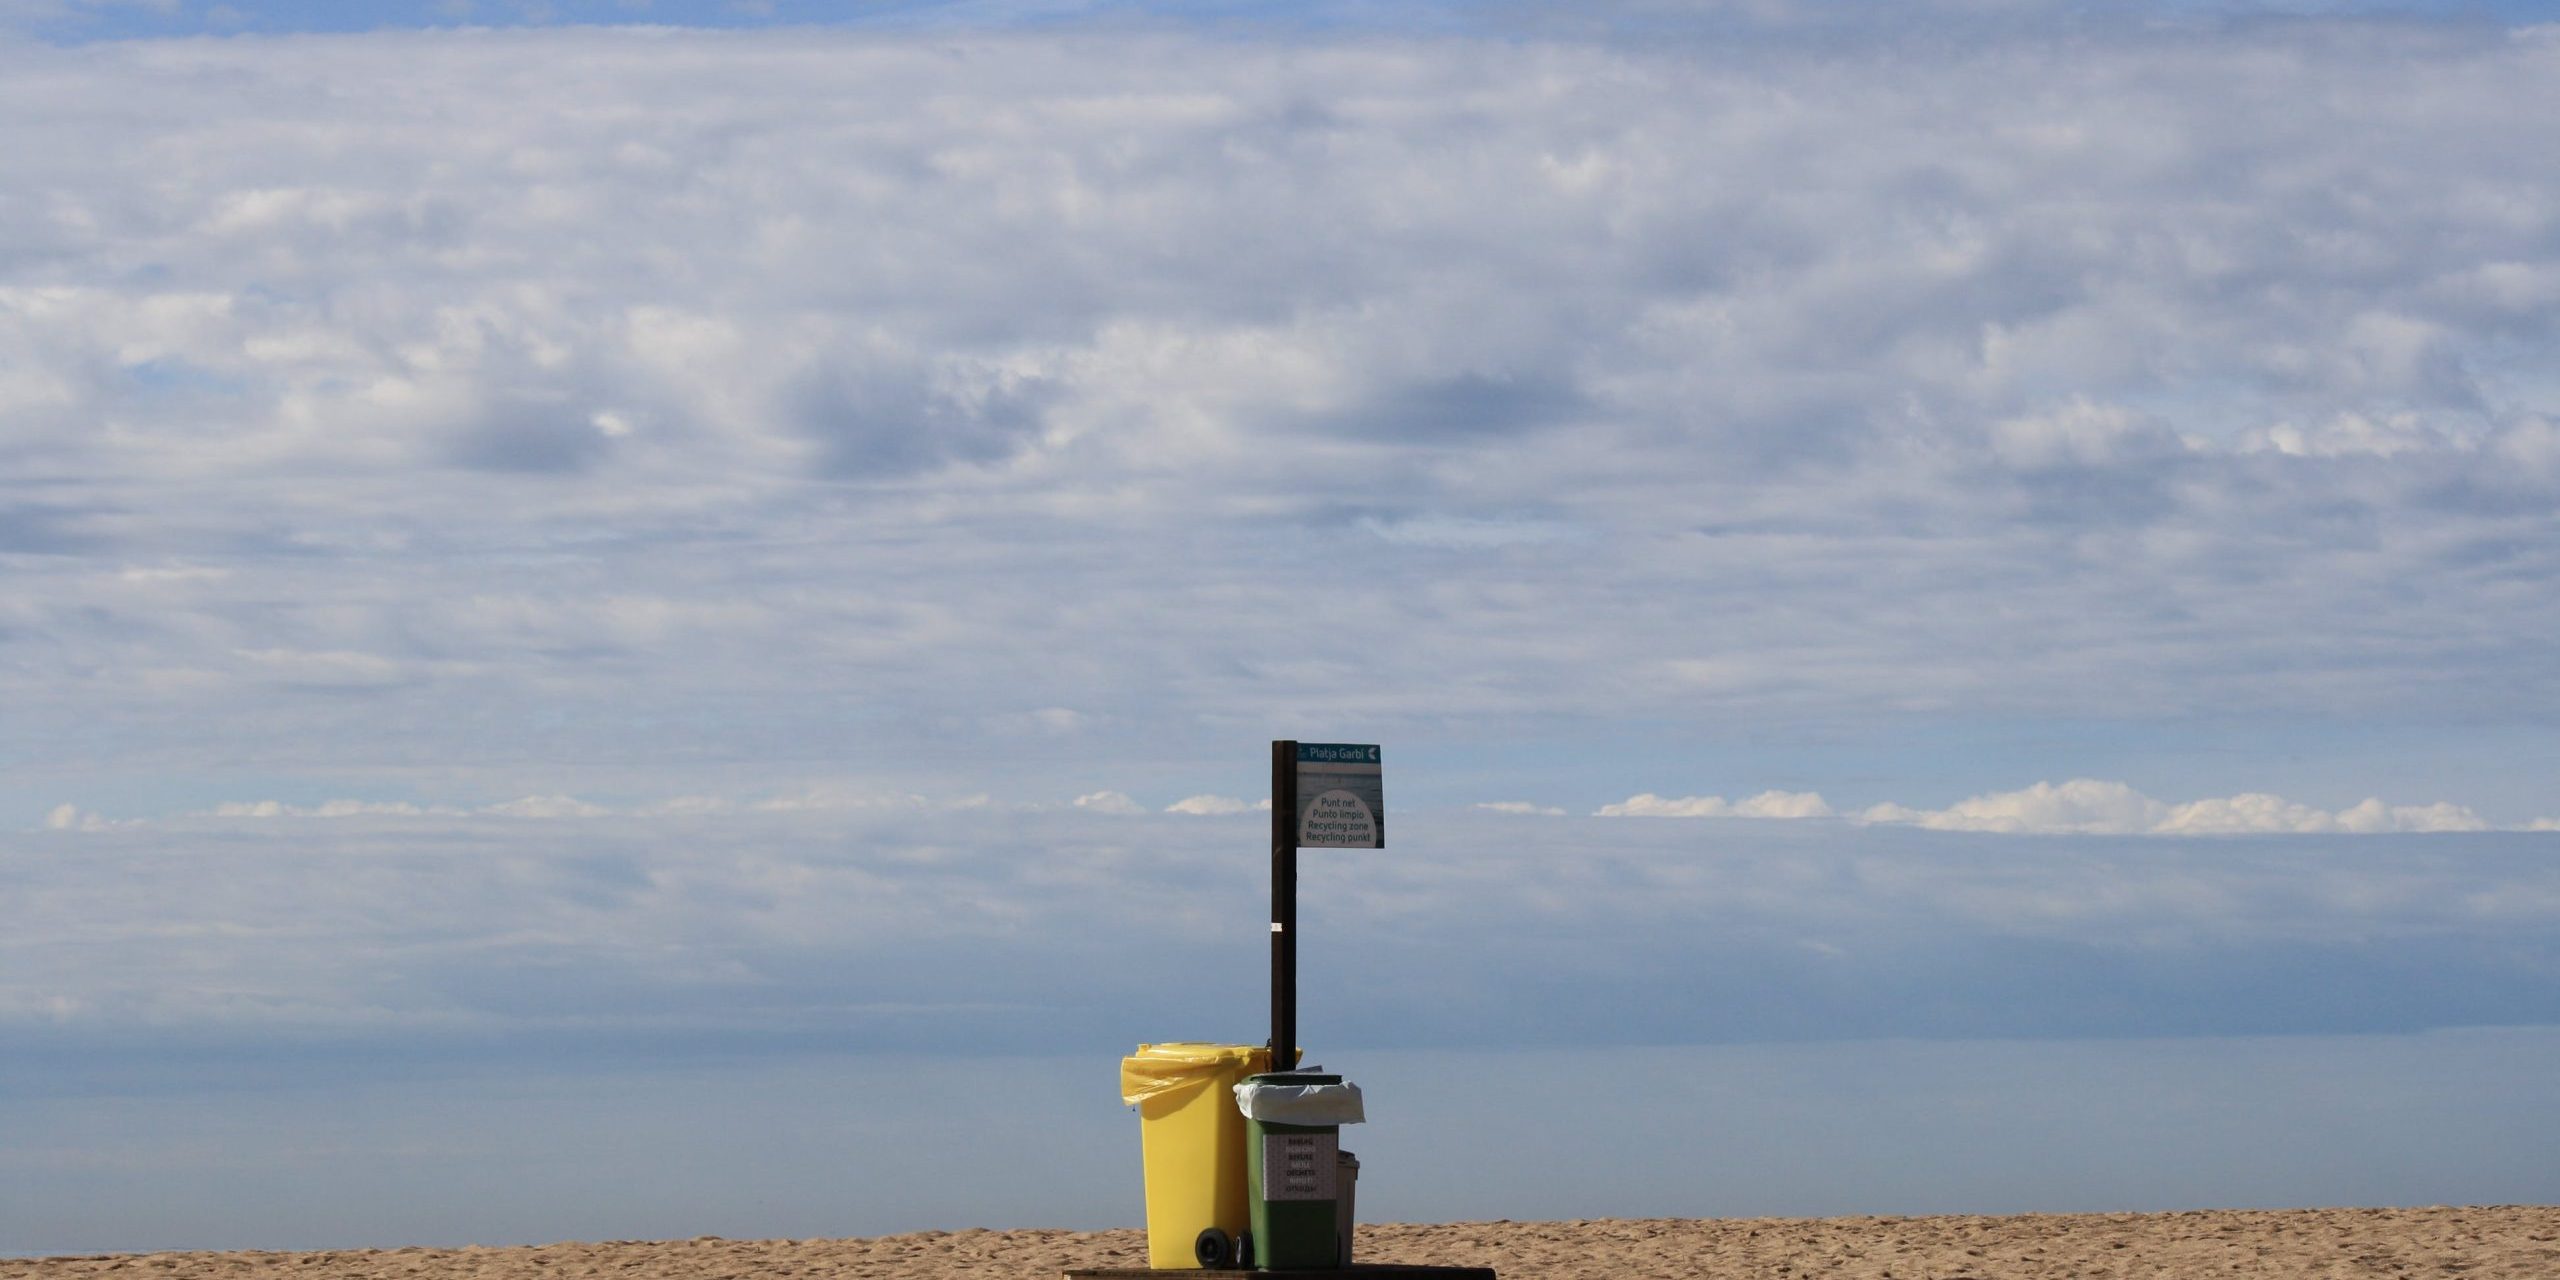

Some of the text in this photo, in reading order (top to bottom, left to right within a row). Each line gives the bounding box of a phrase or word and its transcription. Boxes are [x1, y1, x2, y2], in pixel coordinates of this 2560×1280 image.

[1309, 747, 1337, 761] Platja
[1321, 797, 1356, 808] Punt net
[1313, 809, 1365, 821] Punto limpio
[1308, 820, 1369, 832] Recycling zone
[1306, 832, 1371, 844] Recycling punkt
